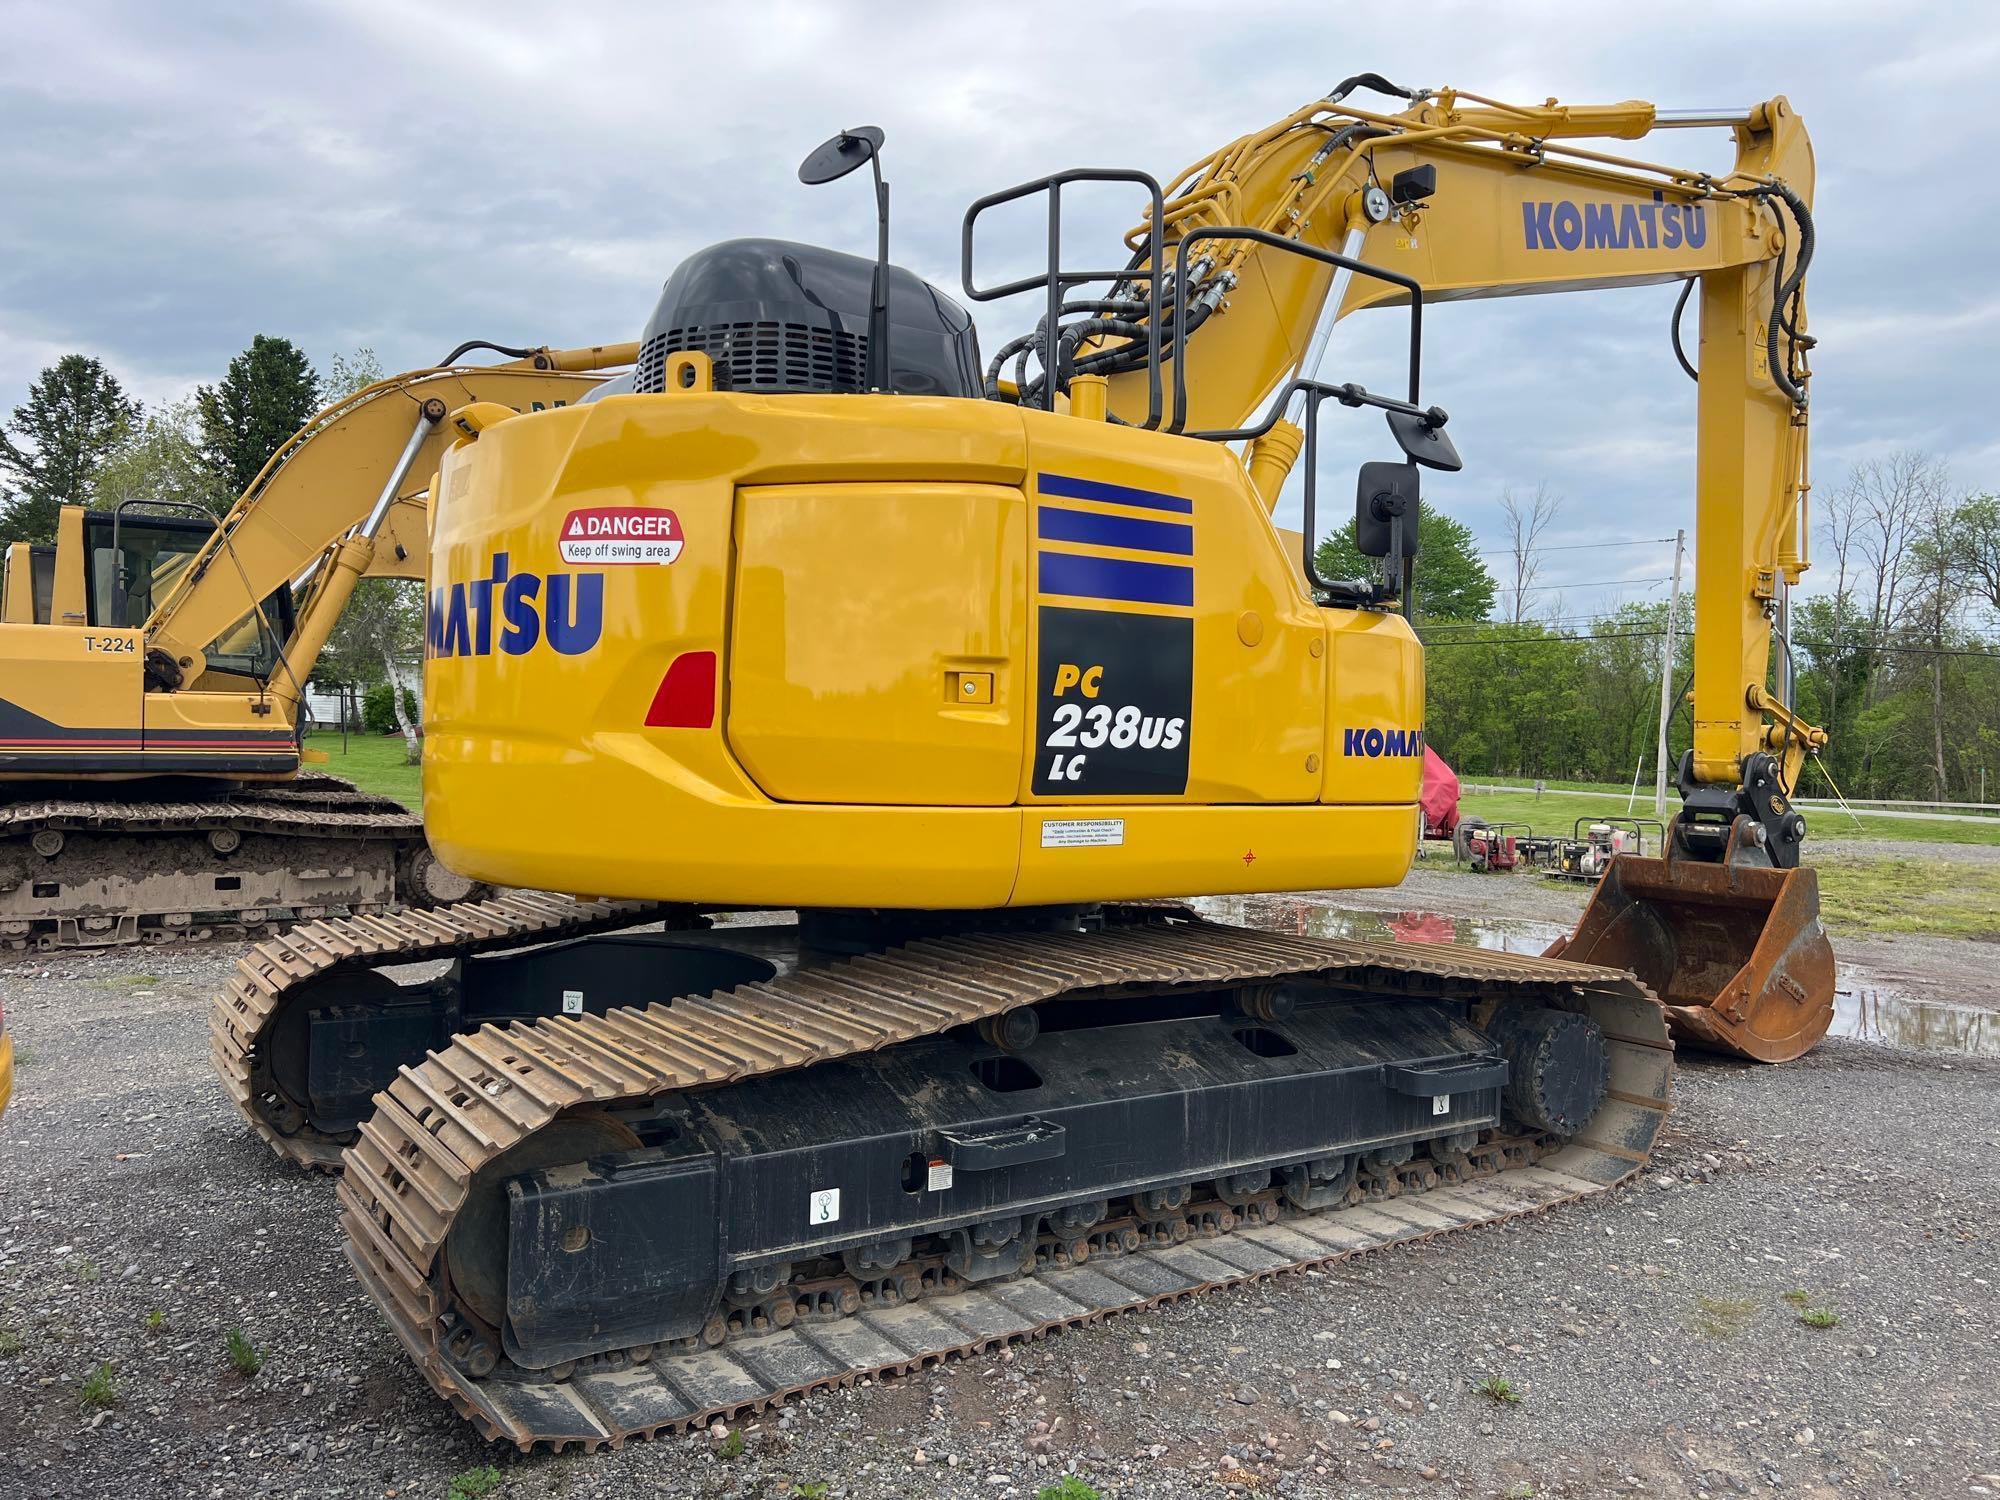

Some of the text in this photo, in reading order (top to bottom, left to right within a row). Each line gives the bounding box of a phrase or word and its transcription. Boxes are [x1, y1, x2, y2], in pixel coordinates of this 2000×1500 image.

[1521, 188, 1707, 252] KOMATSU
[587, 516, 671, 536] DANGER
[568, 543, 671, 559] Keep off swing area
[84, 636, 135, 653] T-224
[1052, 664, 1104, 698] PC
[1047, 754, 1086, 781] LC
